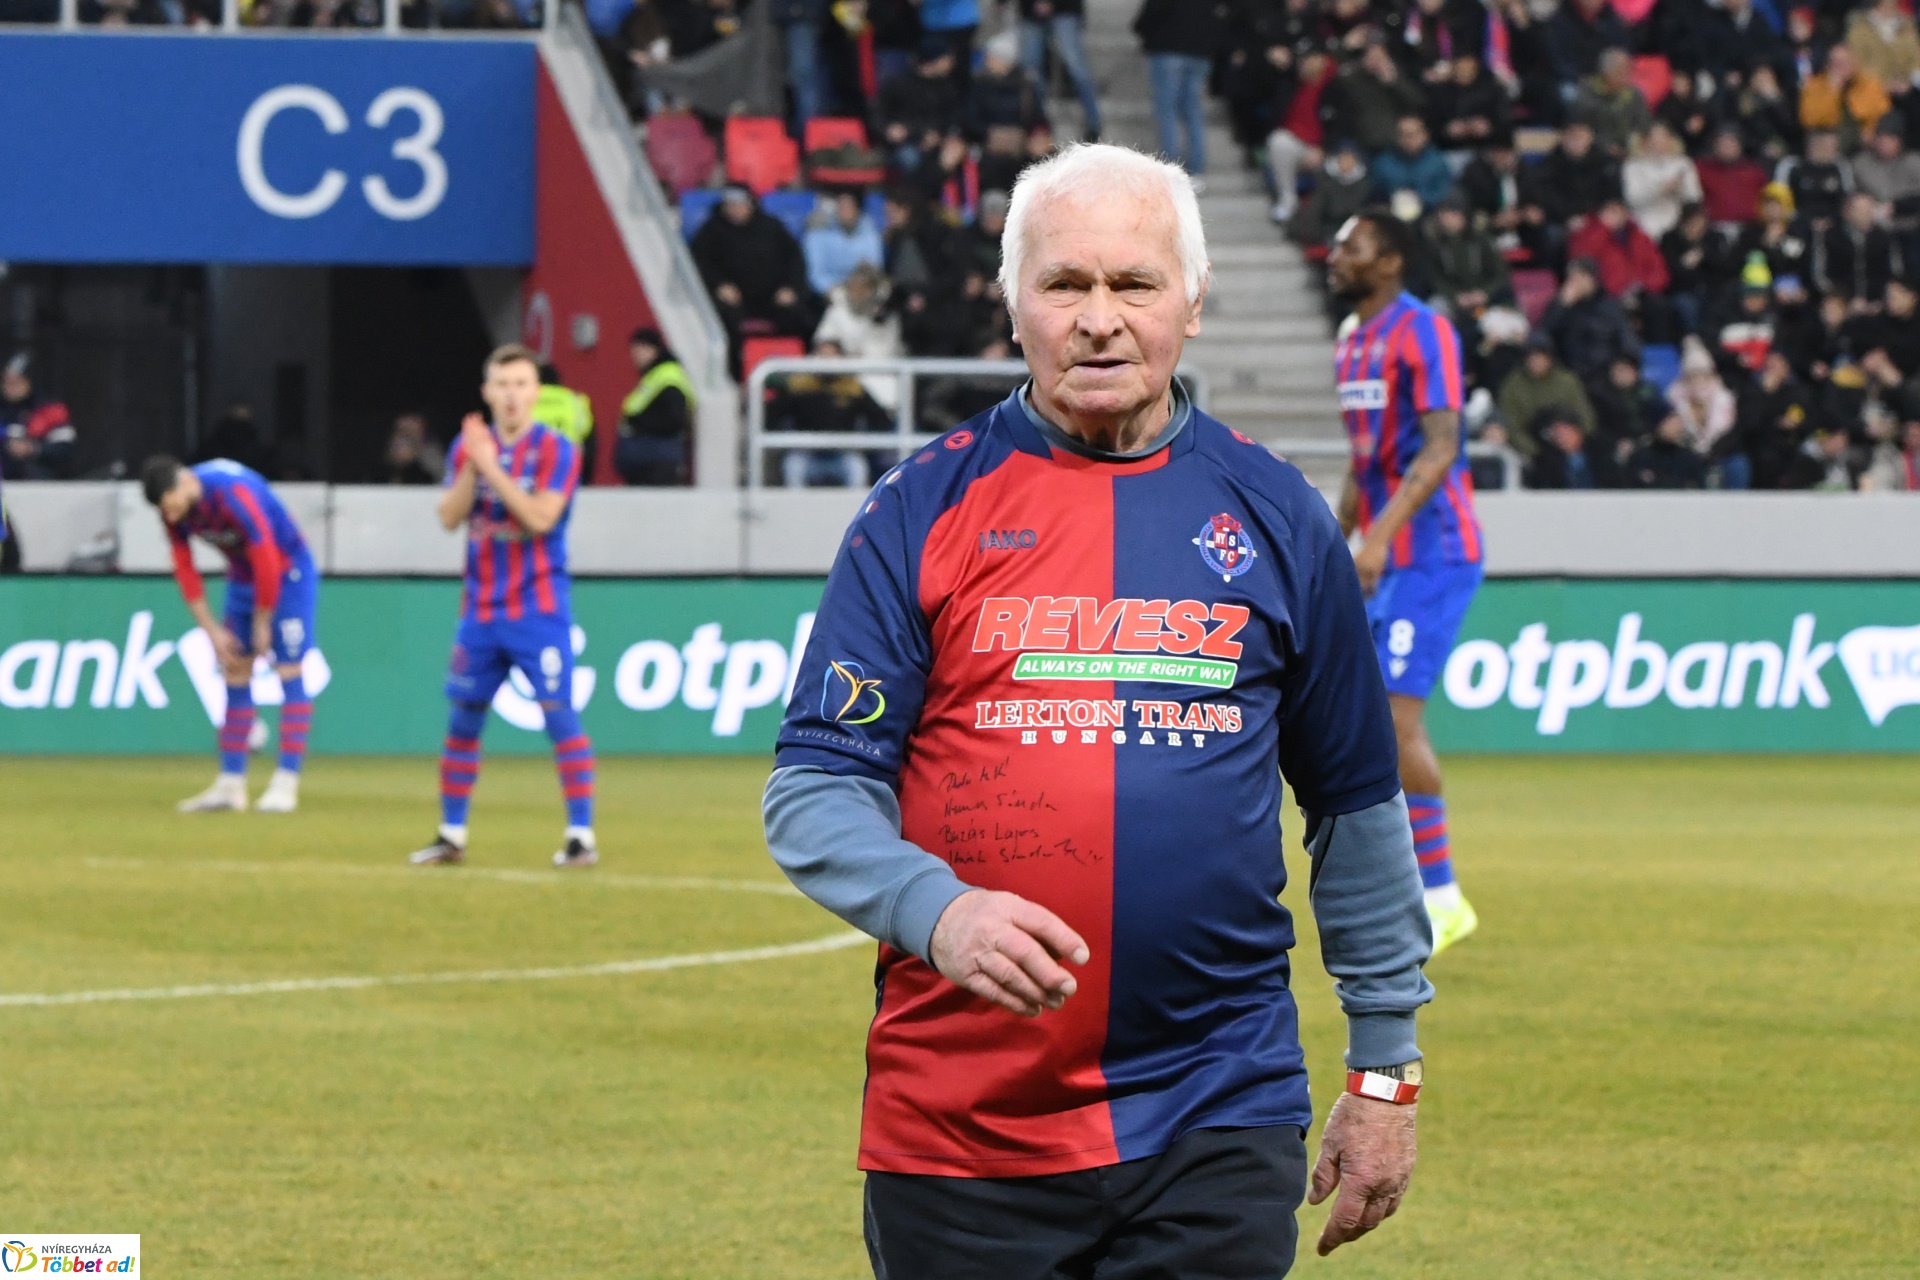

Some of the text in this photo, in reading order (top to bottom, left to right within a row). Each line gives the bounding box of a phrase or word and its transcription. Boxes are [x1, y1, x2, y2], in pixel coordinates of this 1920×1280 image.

[236, 84, 449, 221] C3
[978, 529, 1037, 553] JAKO
[972, 596, 1250, 660] REVESZ
[1388, 618, 1415, 656] 8
[1019, 659, 1232, 682] ALWAYS ON THE RIGHT WAY
[1443, 612, 1836, 735] otpbank
[975, 700, 1242, 733] LERTON TRANS
[1021, 730, 1206, 747] HUNGARY
